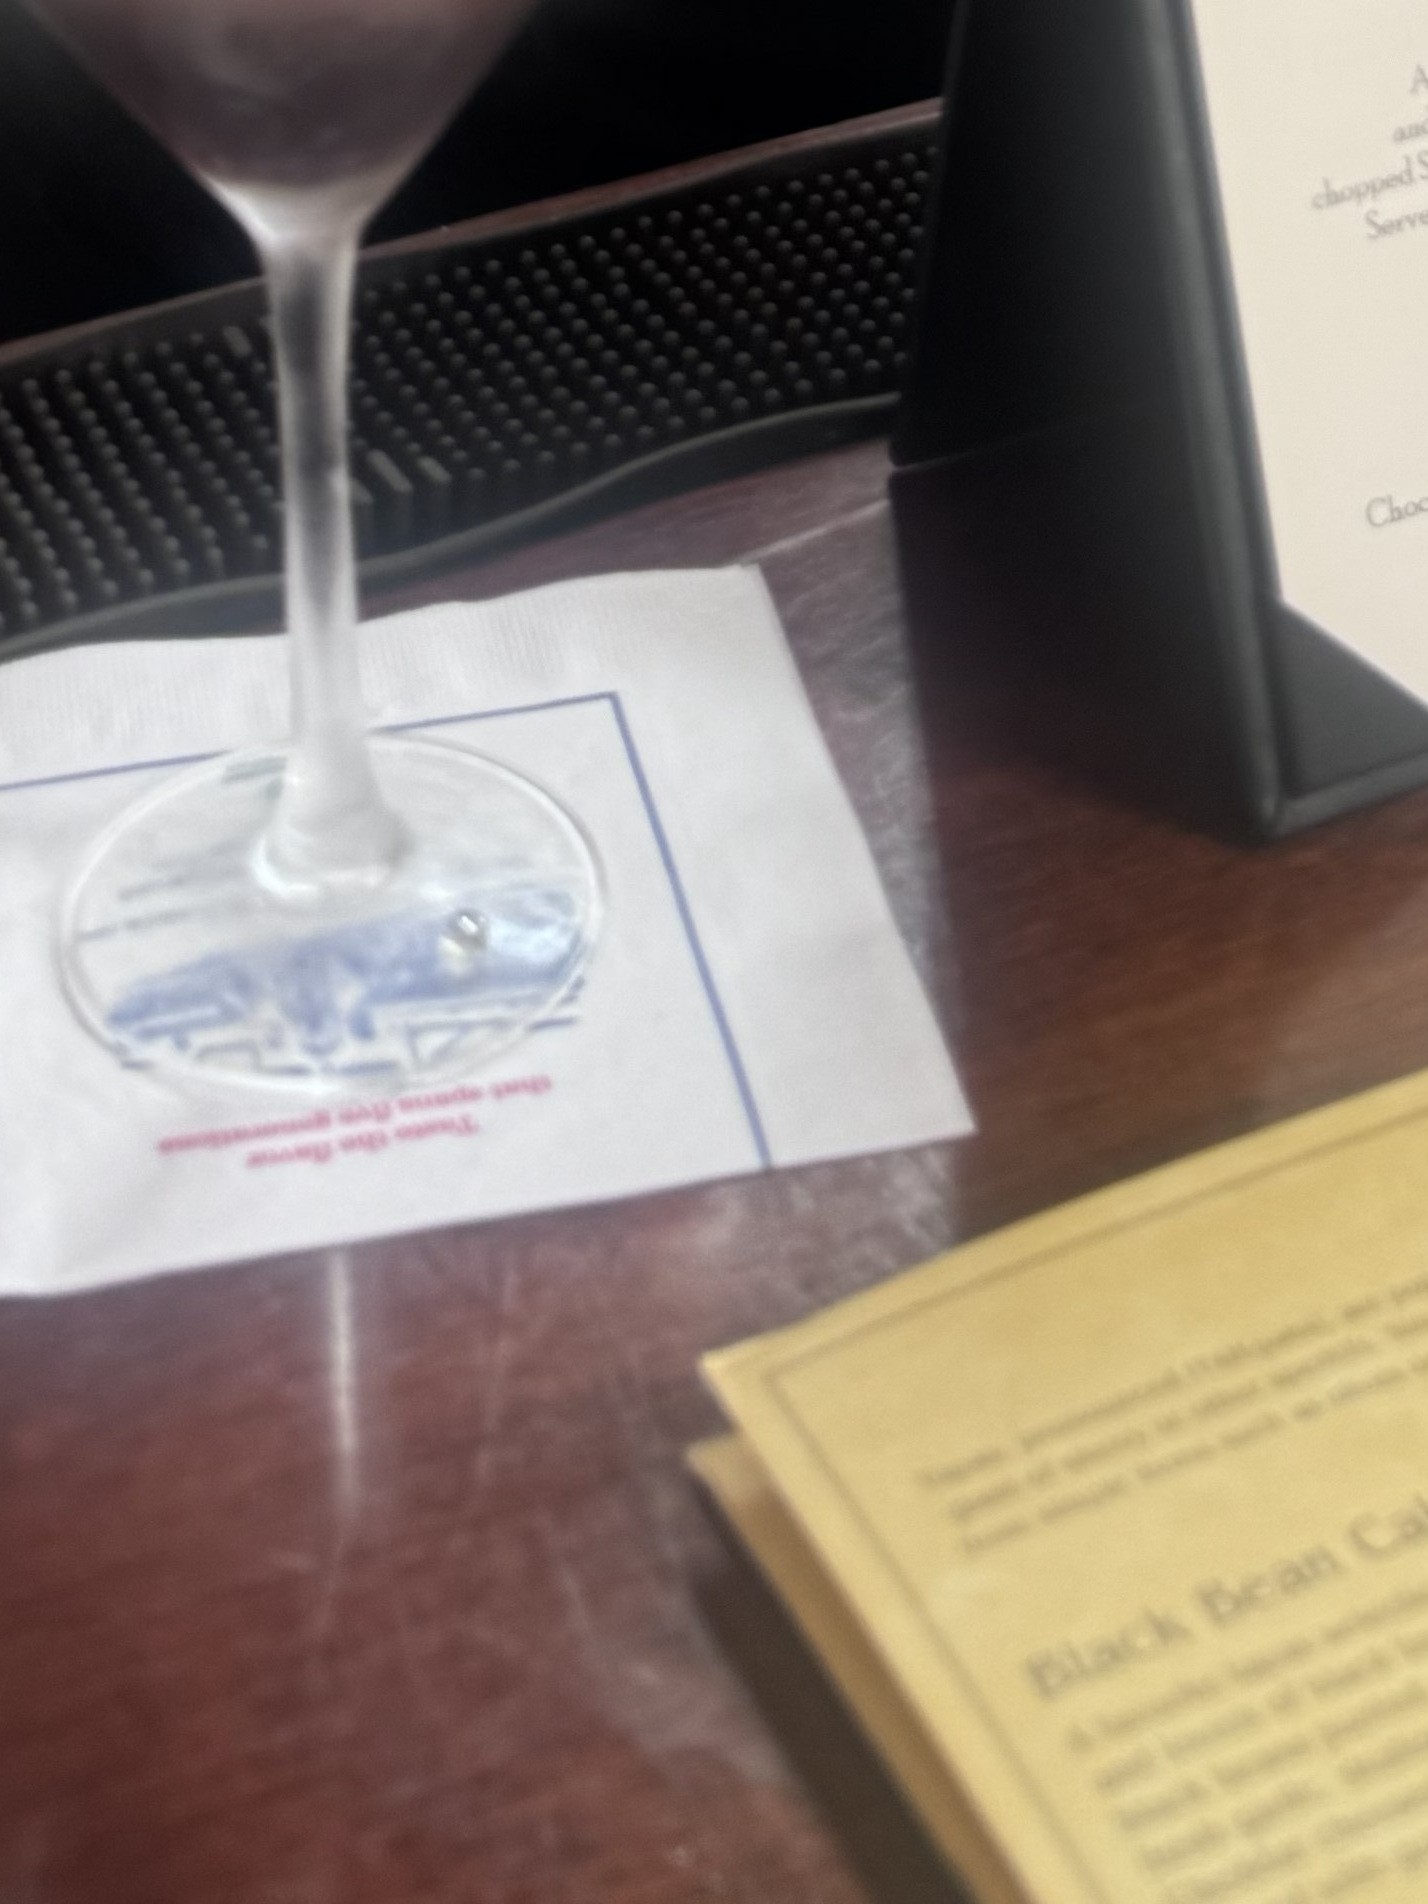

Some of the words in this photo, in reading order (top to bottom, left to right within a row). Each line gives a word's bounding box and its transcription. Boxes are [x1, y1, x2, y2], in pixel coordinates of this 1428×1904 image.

[1310, 154, 1417, 208] chopped
[1025, 1605, 1192, 1701] Black
[1193, 1542, 1339, 1631] Bean
